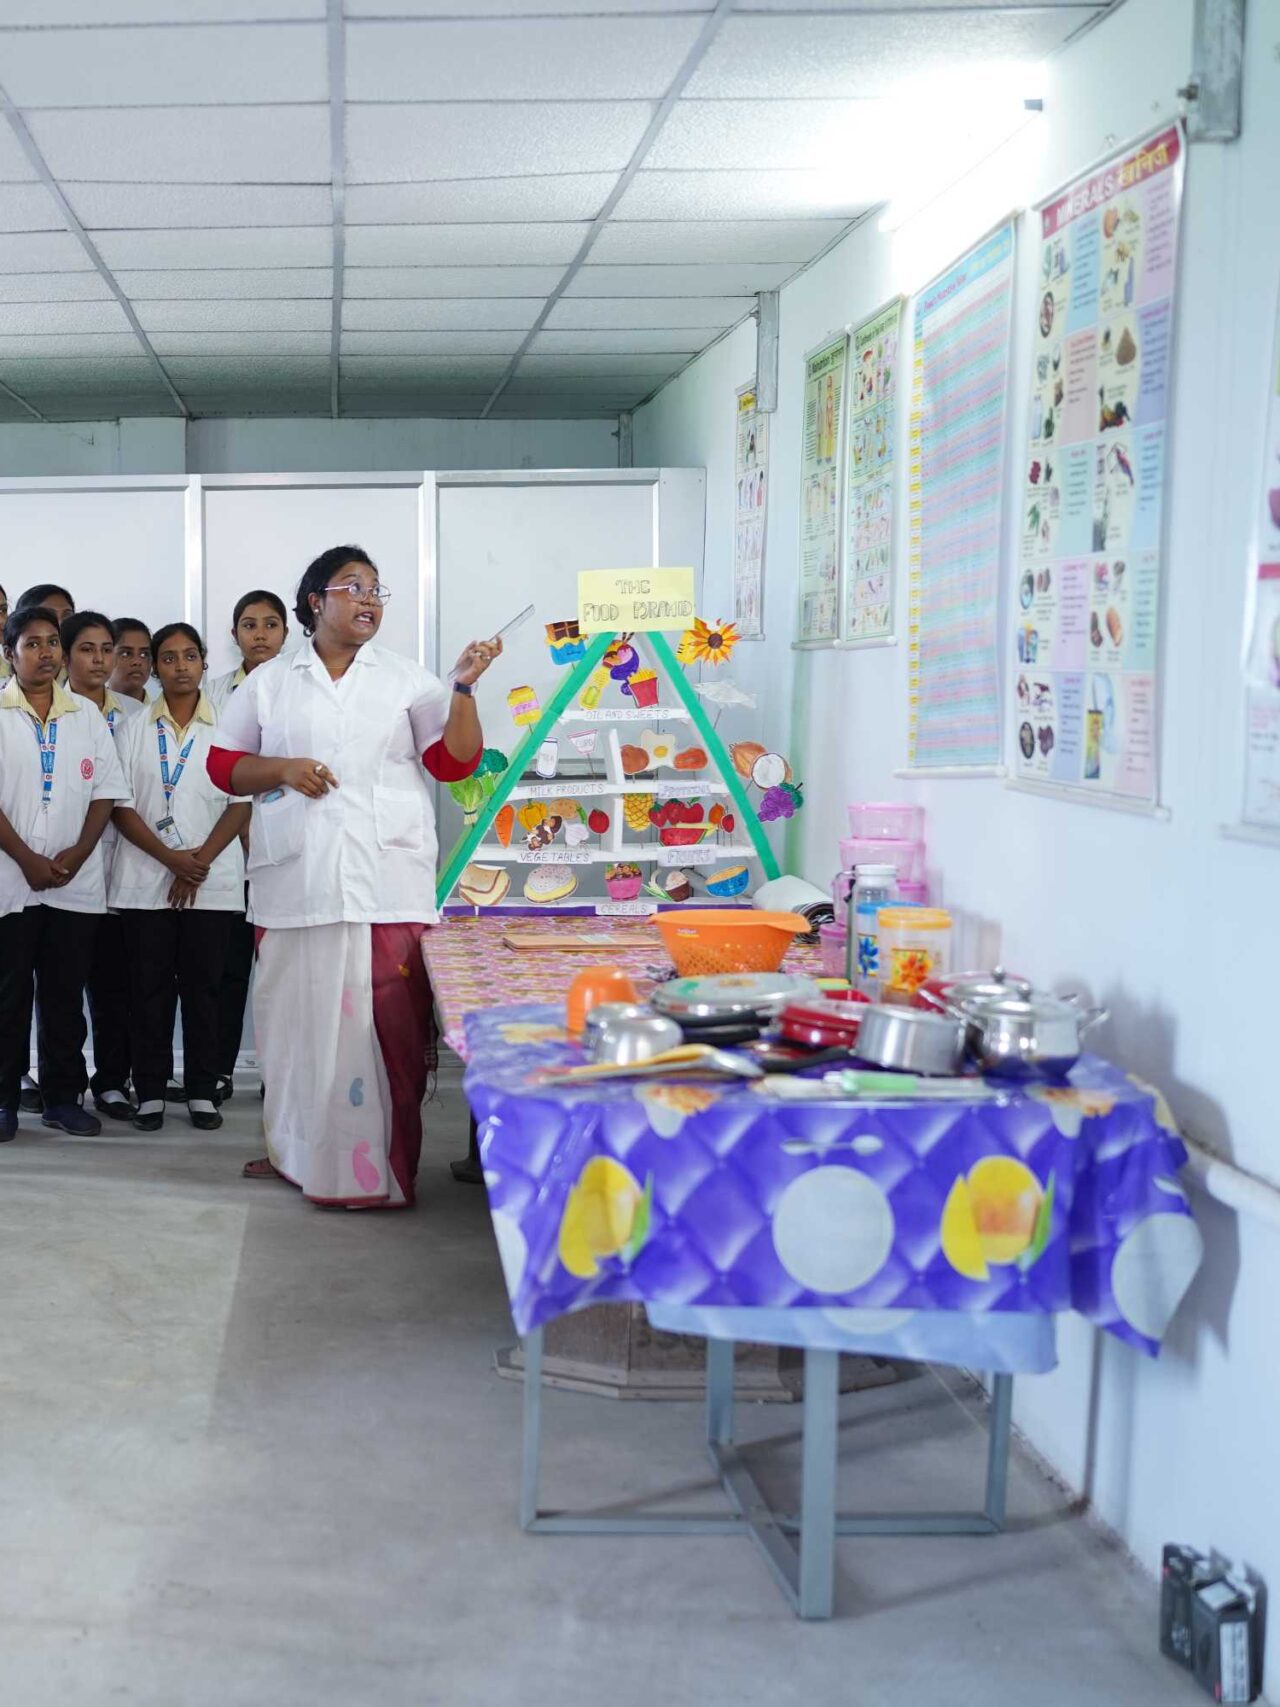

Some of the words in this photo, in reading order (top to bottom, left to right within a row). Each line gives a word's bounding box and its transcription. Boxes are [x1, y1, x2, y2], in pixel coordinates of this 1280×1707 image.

[583, 602, 619, 622] FOOD
[625, 709, 669, 718] SWEETS
[529, 786, 554, 796] MILK
[556, 784, 605, 795] PRODUCTS
[520, 852, 590, 863] VEGETABLES
[601, 904, 648, 914] CEREALS
